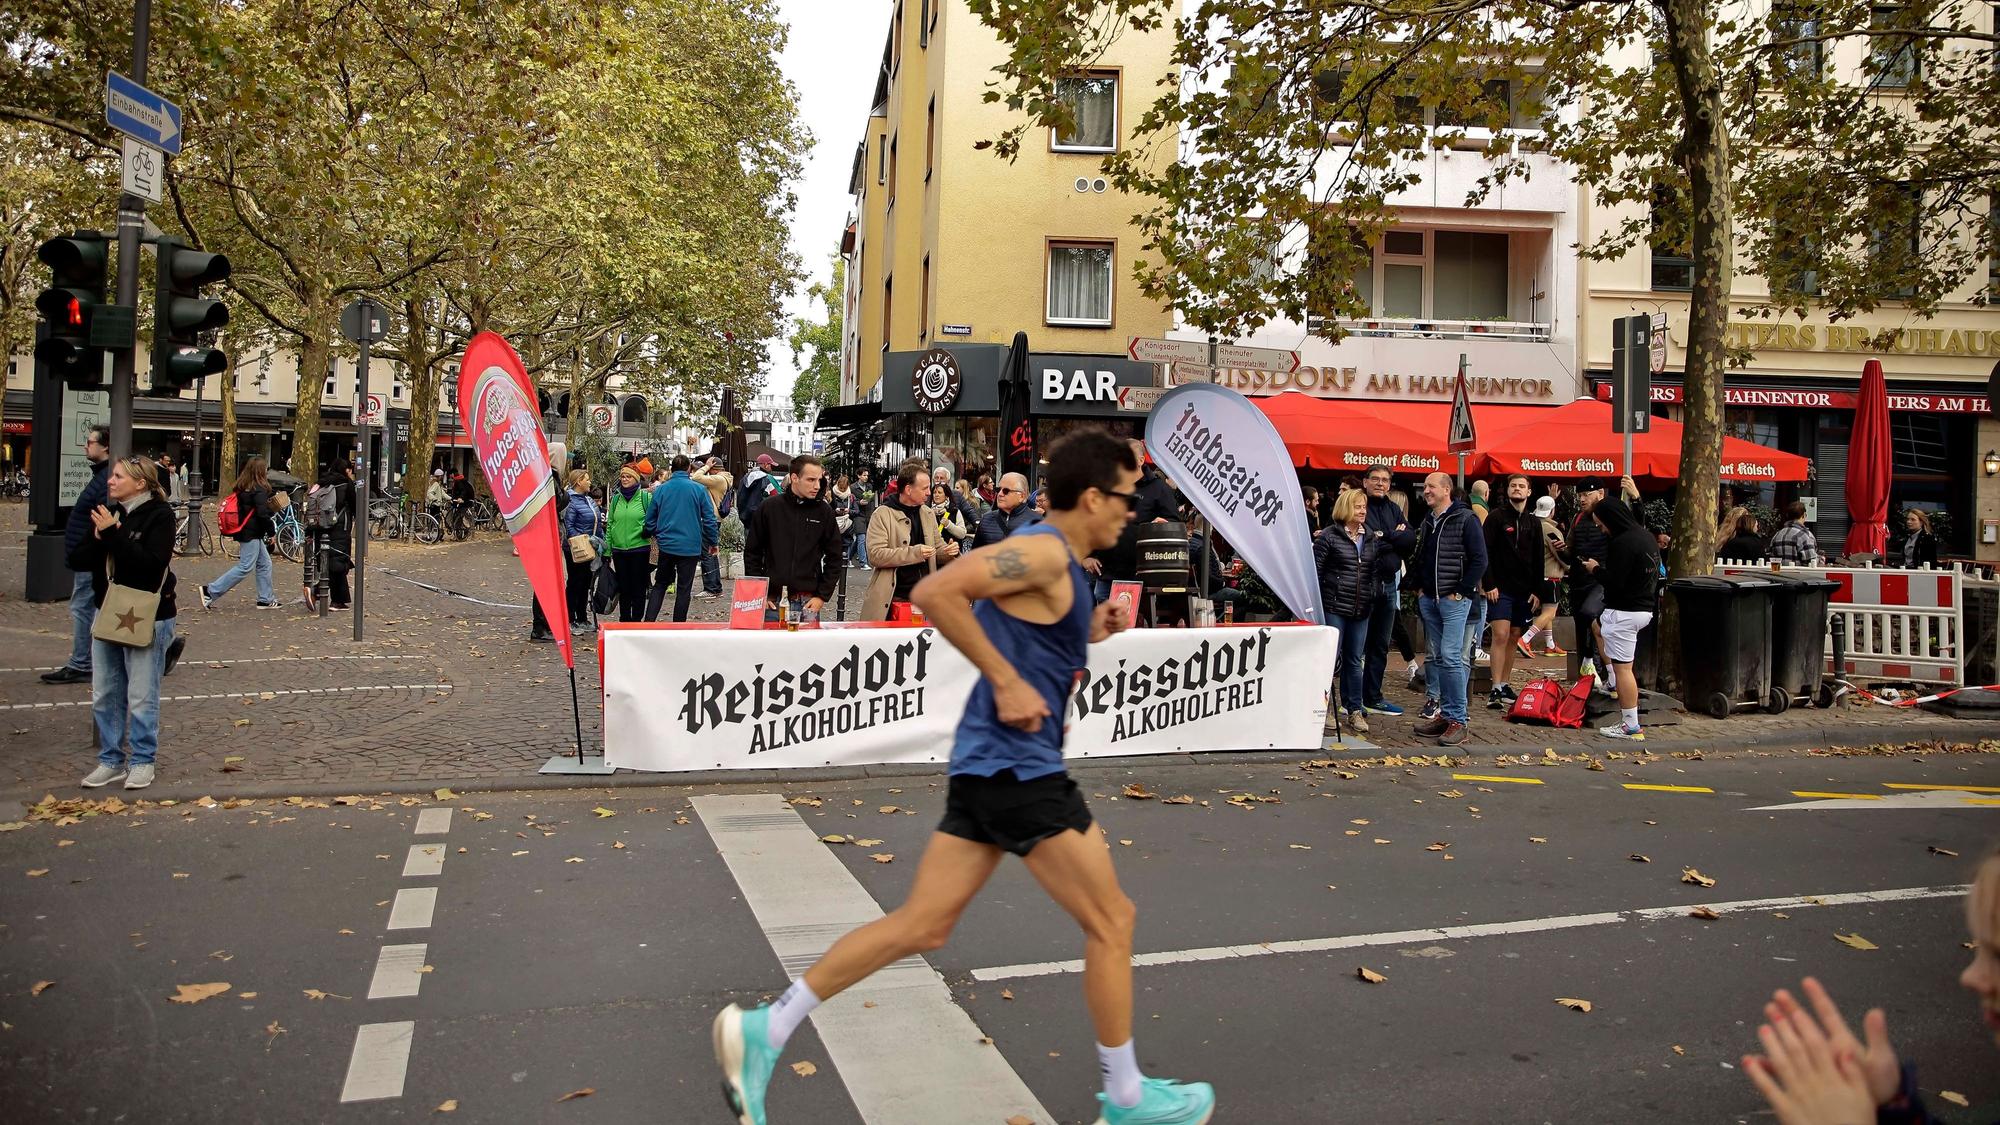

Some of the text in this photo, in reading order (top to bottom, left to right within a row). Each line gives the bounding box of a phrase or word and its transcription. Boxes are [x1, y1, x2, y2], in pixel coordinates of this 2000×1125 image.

[112, 92, 163, 128] Einbahnstraße
[1144, 341, 1180, 351] Königsdorf
[1727, 322, 1817, 350] TERS
[921, 353, 951, 369] CAFÉ
[1219, 347, 1254, 358] Rheinufer
[1042, 368, 1118, 401] BAR
[1215, 366, 1357, 390] ISSDORF
[1365, 373, 1402, 393] AM
[1408, 375, 1554, 396] HAHNENTOR
[912, 382, 959, 412] IL BARISTA
[1887, 396, 1930, 410] TERS
[1936, 398, 1966, 412] AM
[596, 411, 610, 421] 30
[1343, 451, 1440, 472] Reissdorf Kölsch
[1521, 458, 1614, 474] Reissdorf Kölsch
[1738, 462, 1776, 479] Kölsch
[1145, 551, 1178, 561] Reissdorf
[678, 628, 934, 735] Reissdorf
[748, 686, 925, 755] ALKOHOLFREI
[1111, 677, 1264, 743] ALKOHOLFREI
